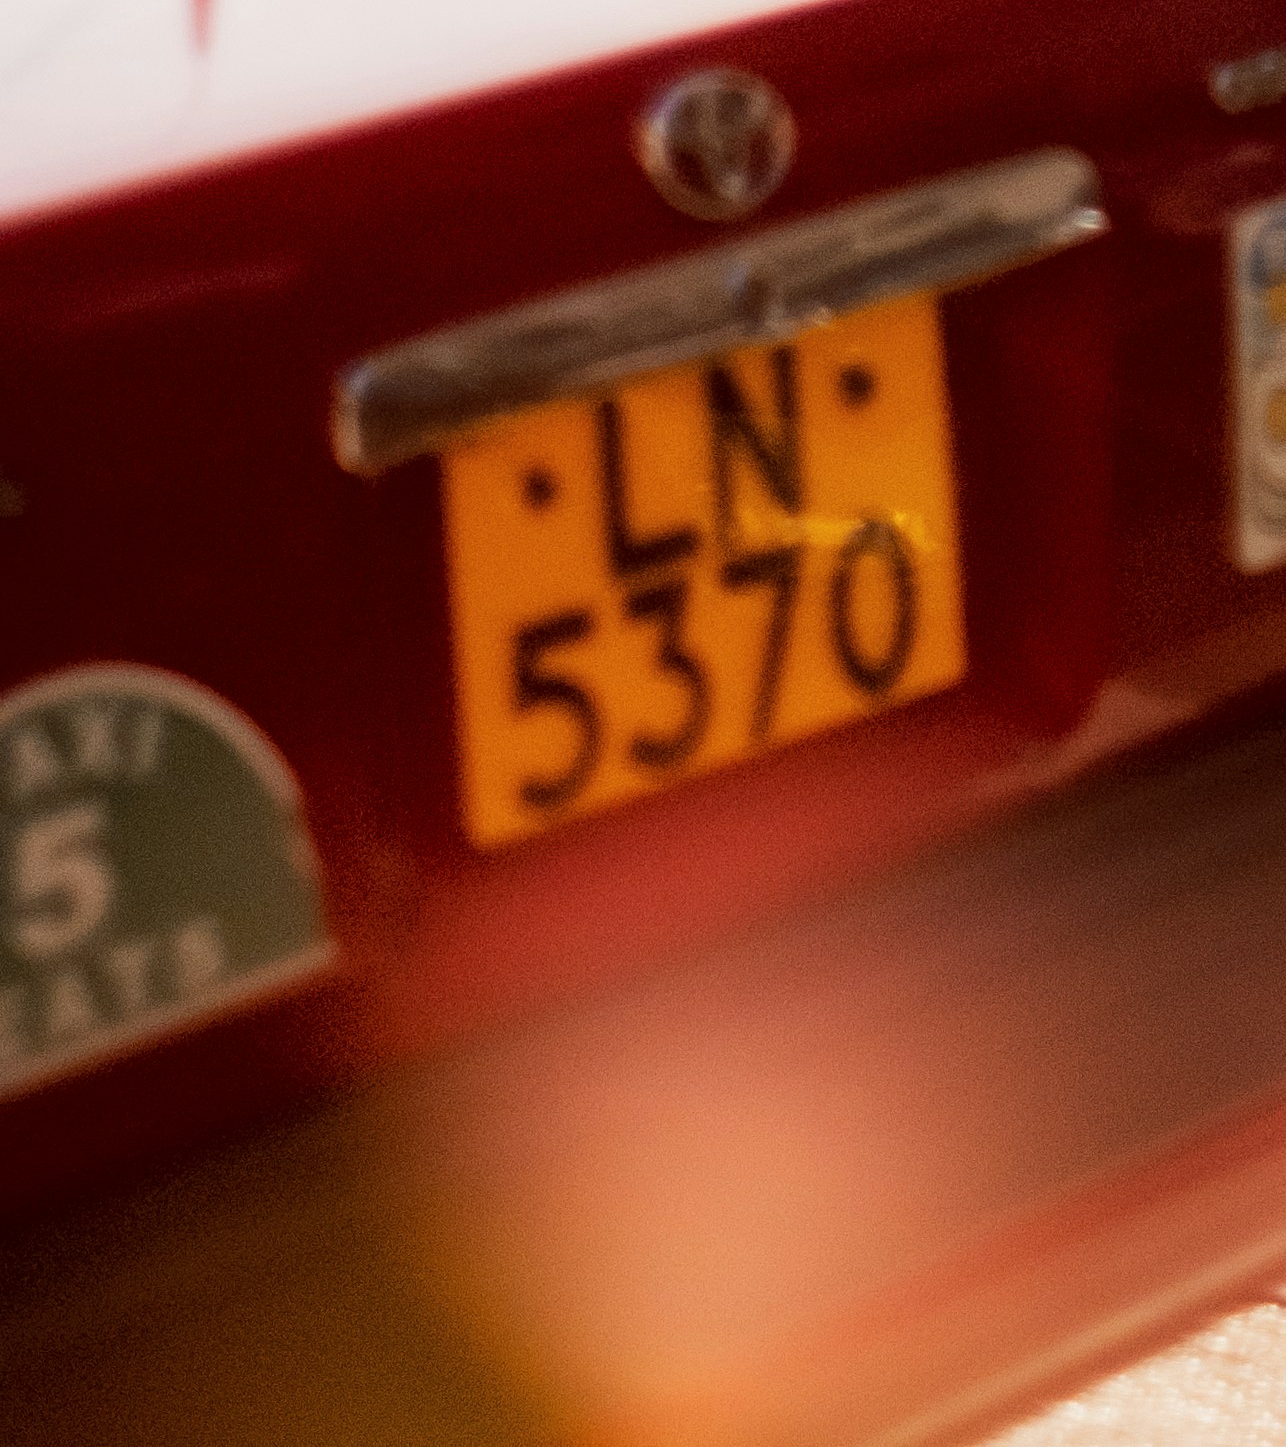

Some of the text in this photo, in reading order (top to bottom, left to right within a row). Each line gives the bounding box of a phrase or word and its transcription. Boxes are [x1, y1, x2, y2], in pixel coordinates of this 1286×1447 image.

[602, 344, 806, 578] LN
[513, 514, 920, 810] 5370
[15, 798, 114, 958] 5
